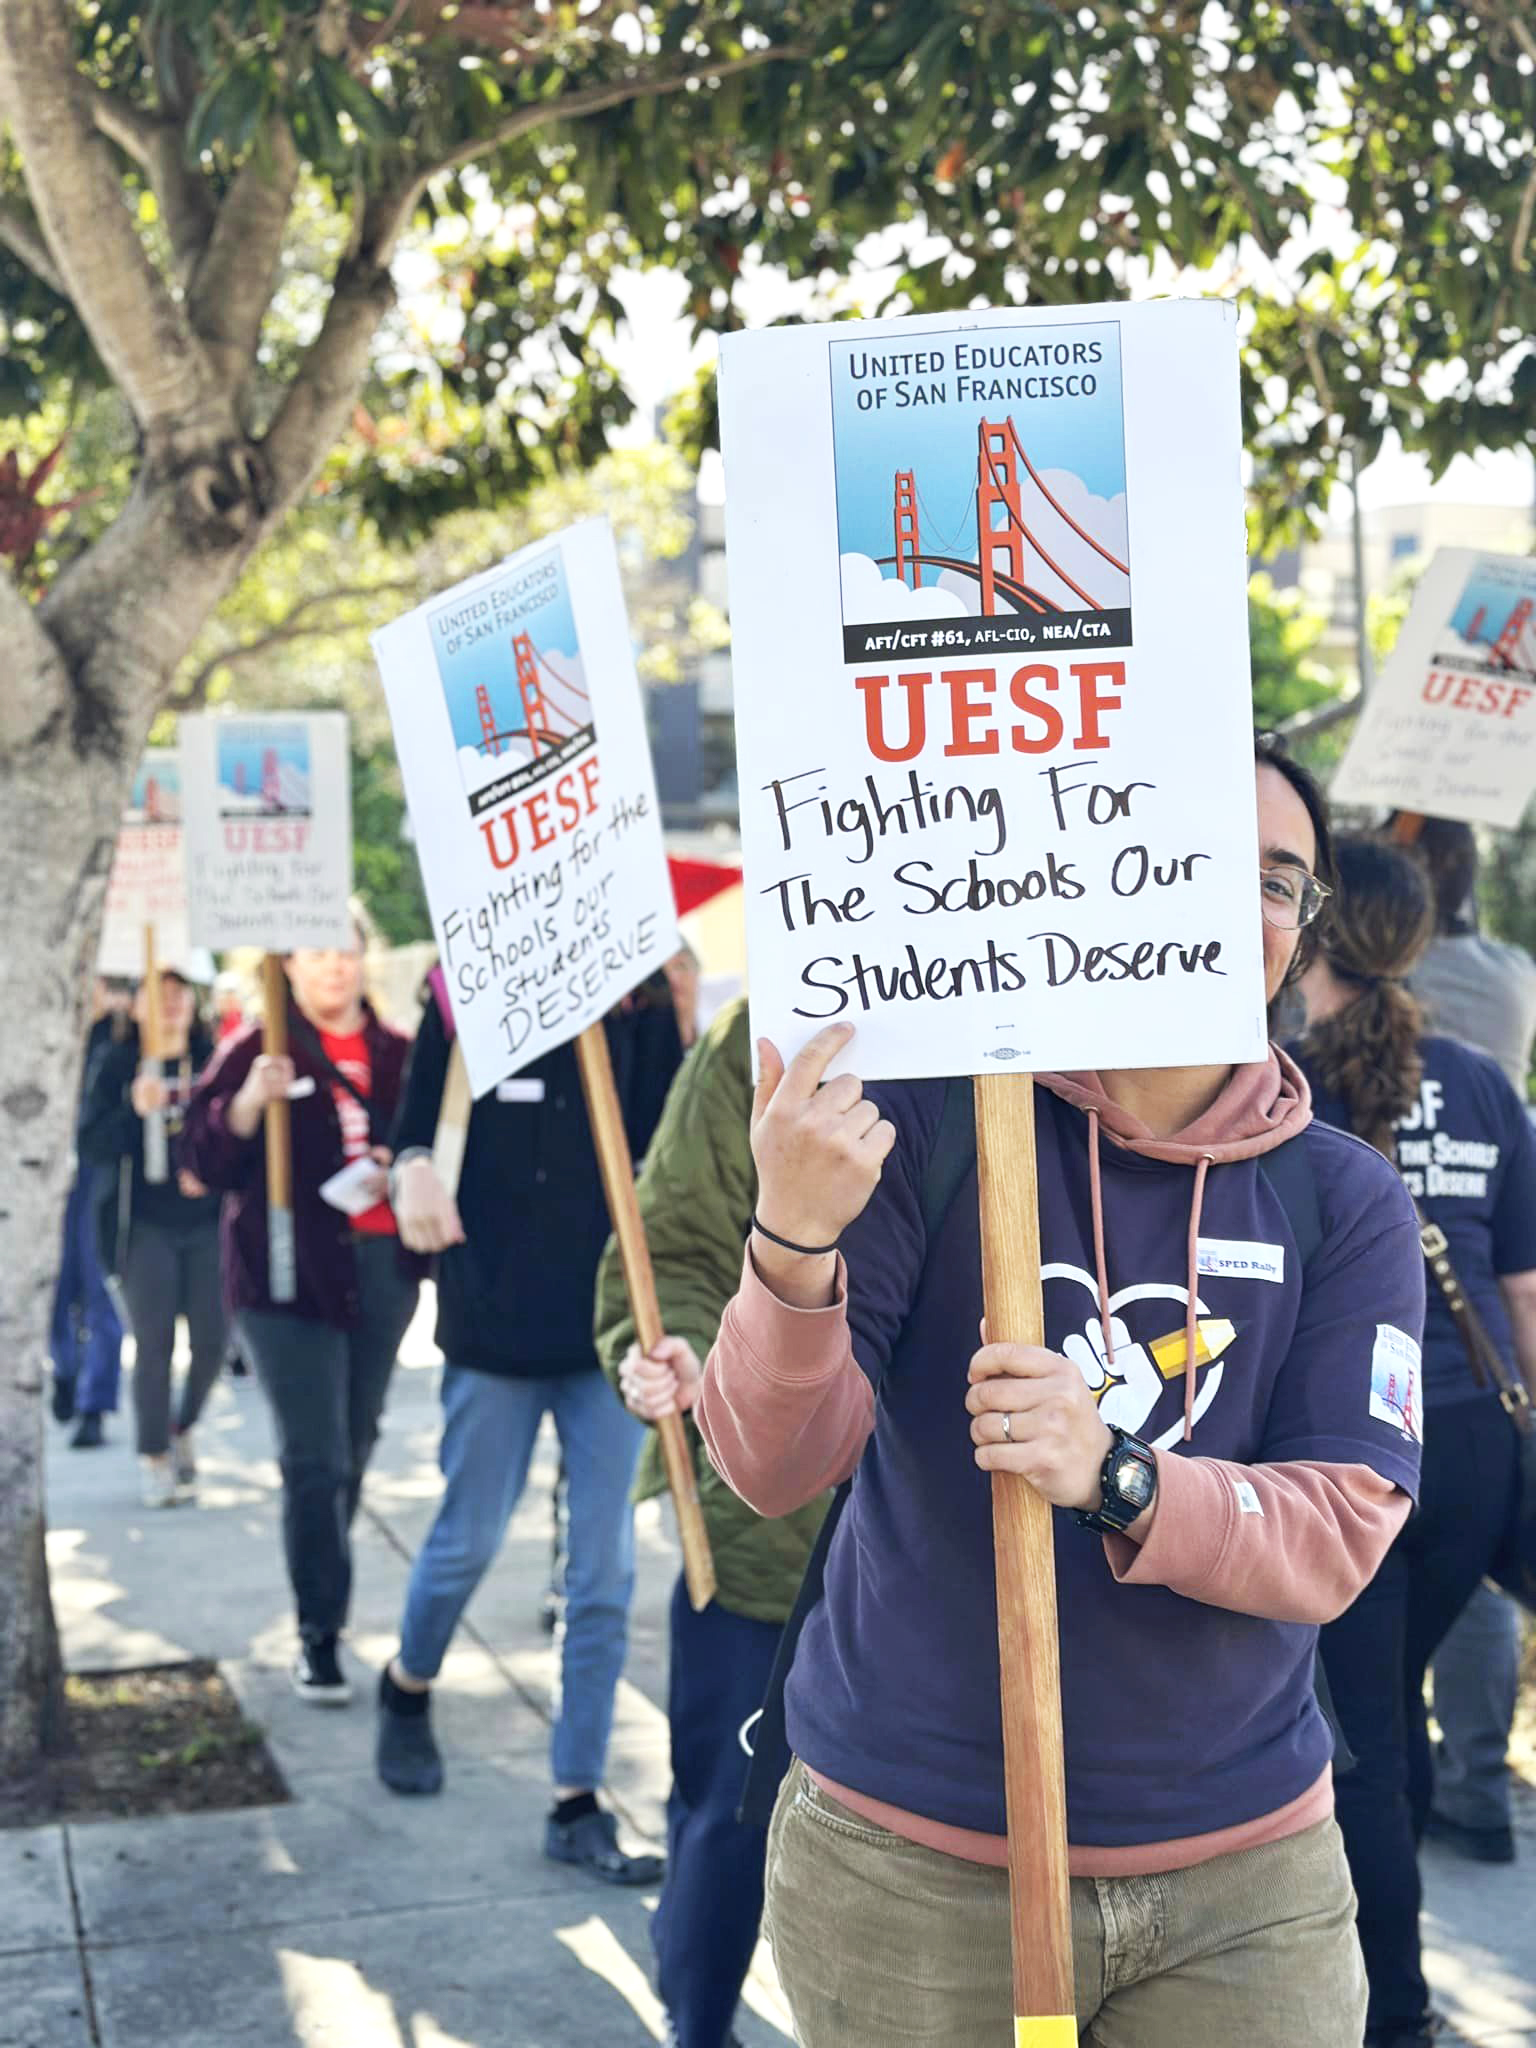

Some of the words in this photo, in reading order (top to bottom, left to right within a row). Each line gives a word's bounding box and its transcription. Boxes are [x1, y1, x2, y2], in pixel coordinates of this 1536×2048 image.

[849, 351, 945, 380] UNITED
[954, 341, 1103, 371] EDUCATORS
[856, 387, 888, 411] OF
[894, 380, 947, 408] SAN
[956, 373, 1098, 402] FRANCISCO
[437, 600, 489, 636] UNITED
[864, 629, 928, 651] AFT/CFT
[930, 629, 972, 648] #61,
[974, 627, 1036, 644] AFL-CIO,
[1042, 618, 1112, 640] NEA/CTA
[854, 661, 1128, 762] UESF
[1421, 670, 1533, 720] UESF
[479, 755, 600, 872] UESF
[761, 767, 1008, 864] Fighting
[1038, 760, 1157, 831] For
[442, 860, 564, 971] Fighting
[568, 828, 602, 877] for
[608, 793, 650, 840] the
[760, 872, 876, 932] The
[1110, 844, 1213, 897] Our
[457, 916, 558, 1006] Schools
[499, 911, 659, 1056] DESERVE
[791, 939, 1027, 1018] Students
[1026, 931, 1229, 988] Deserve
[1218, 1259, 1249, 1269] SPED
[1251, 1261, 1277, 1275] Rally
